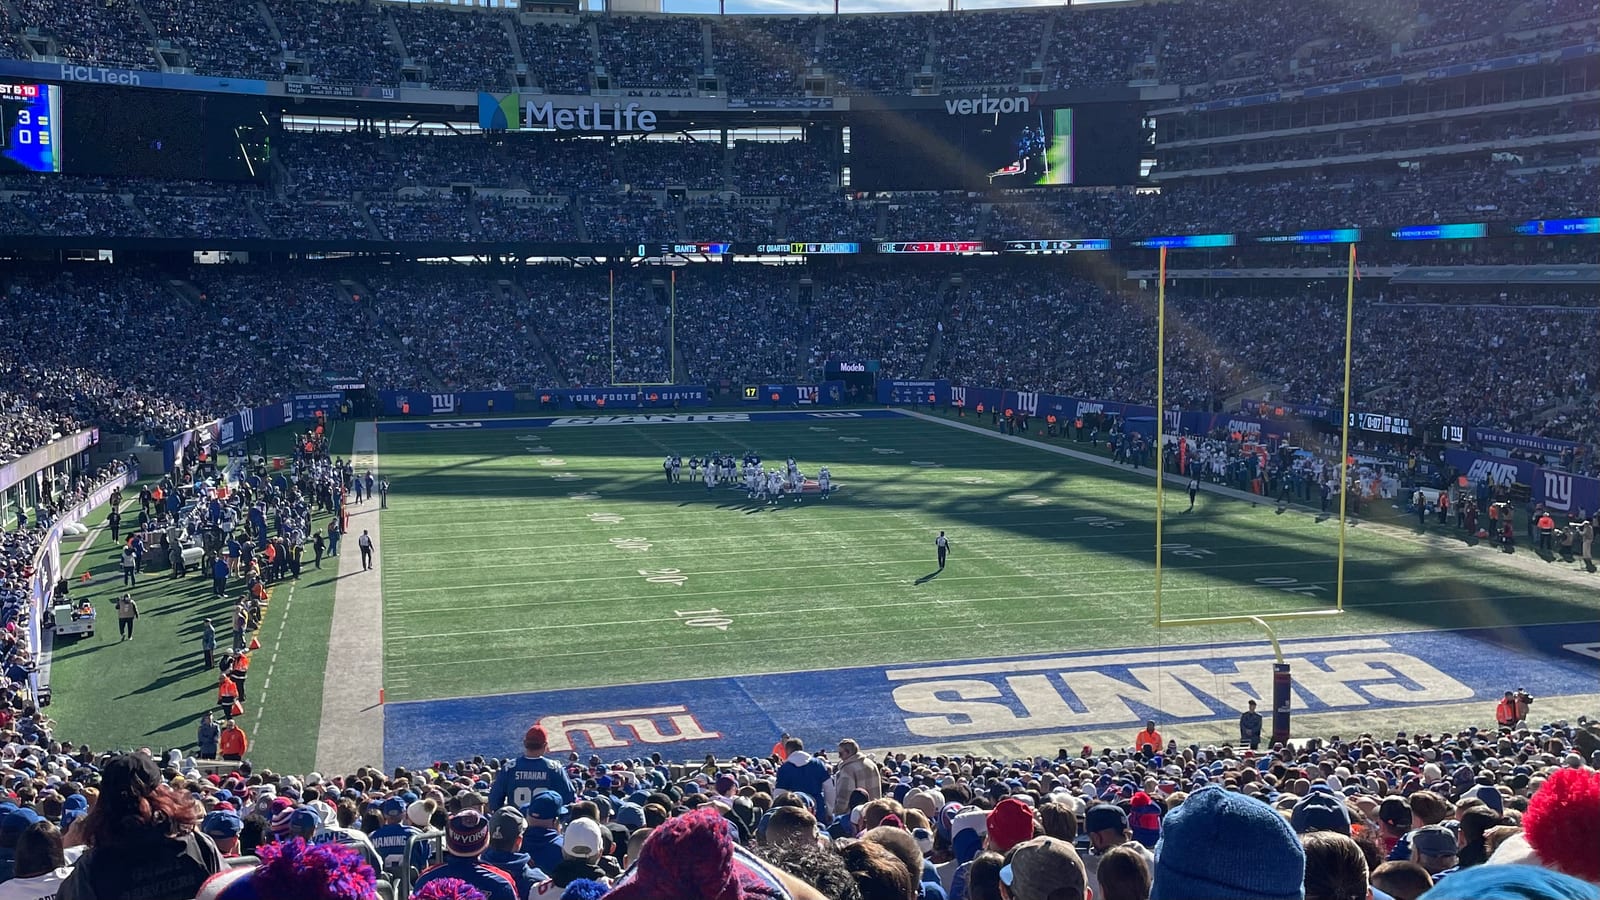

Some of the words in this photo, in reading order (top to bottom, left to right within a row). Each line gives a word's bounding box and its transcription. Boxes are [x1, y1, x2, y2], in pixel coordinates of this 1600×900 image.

[61, 65, 140, 86] HCLTech
[23, 86, 35, 95] 10
[945, 94, 1029, 115] verizon
[18, 110, 31, 125] 3
[526, 102, 657, 131] MetLife
[20, 130, 31, 144] 0
[674, 245, 697, 253] GIANTS
[766, 245, 790, 253] QUARTER
[840, 362, 865, 372] Modelo
[569, 394, 597, 402] YORK
[745, 388, 756, 397] 17
[548, 412, 751, 427] GIANTS
[1349, 413, 1355, 426] 3
[1467, 459, 1518, 487] GIANTS
[674, 607, 734, 628] 10
[887, 640, 1475, 739] GIANTS
[515, 771, 547, 780] STRAHAN
[372, 835, 406, 848] MANNING
